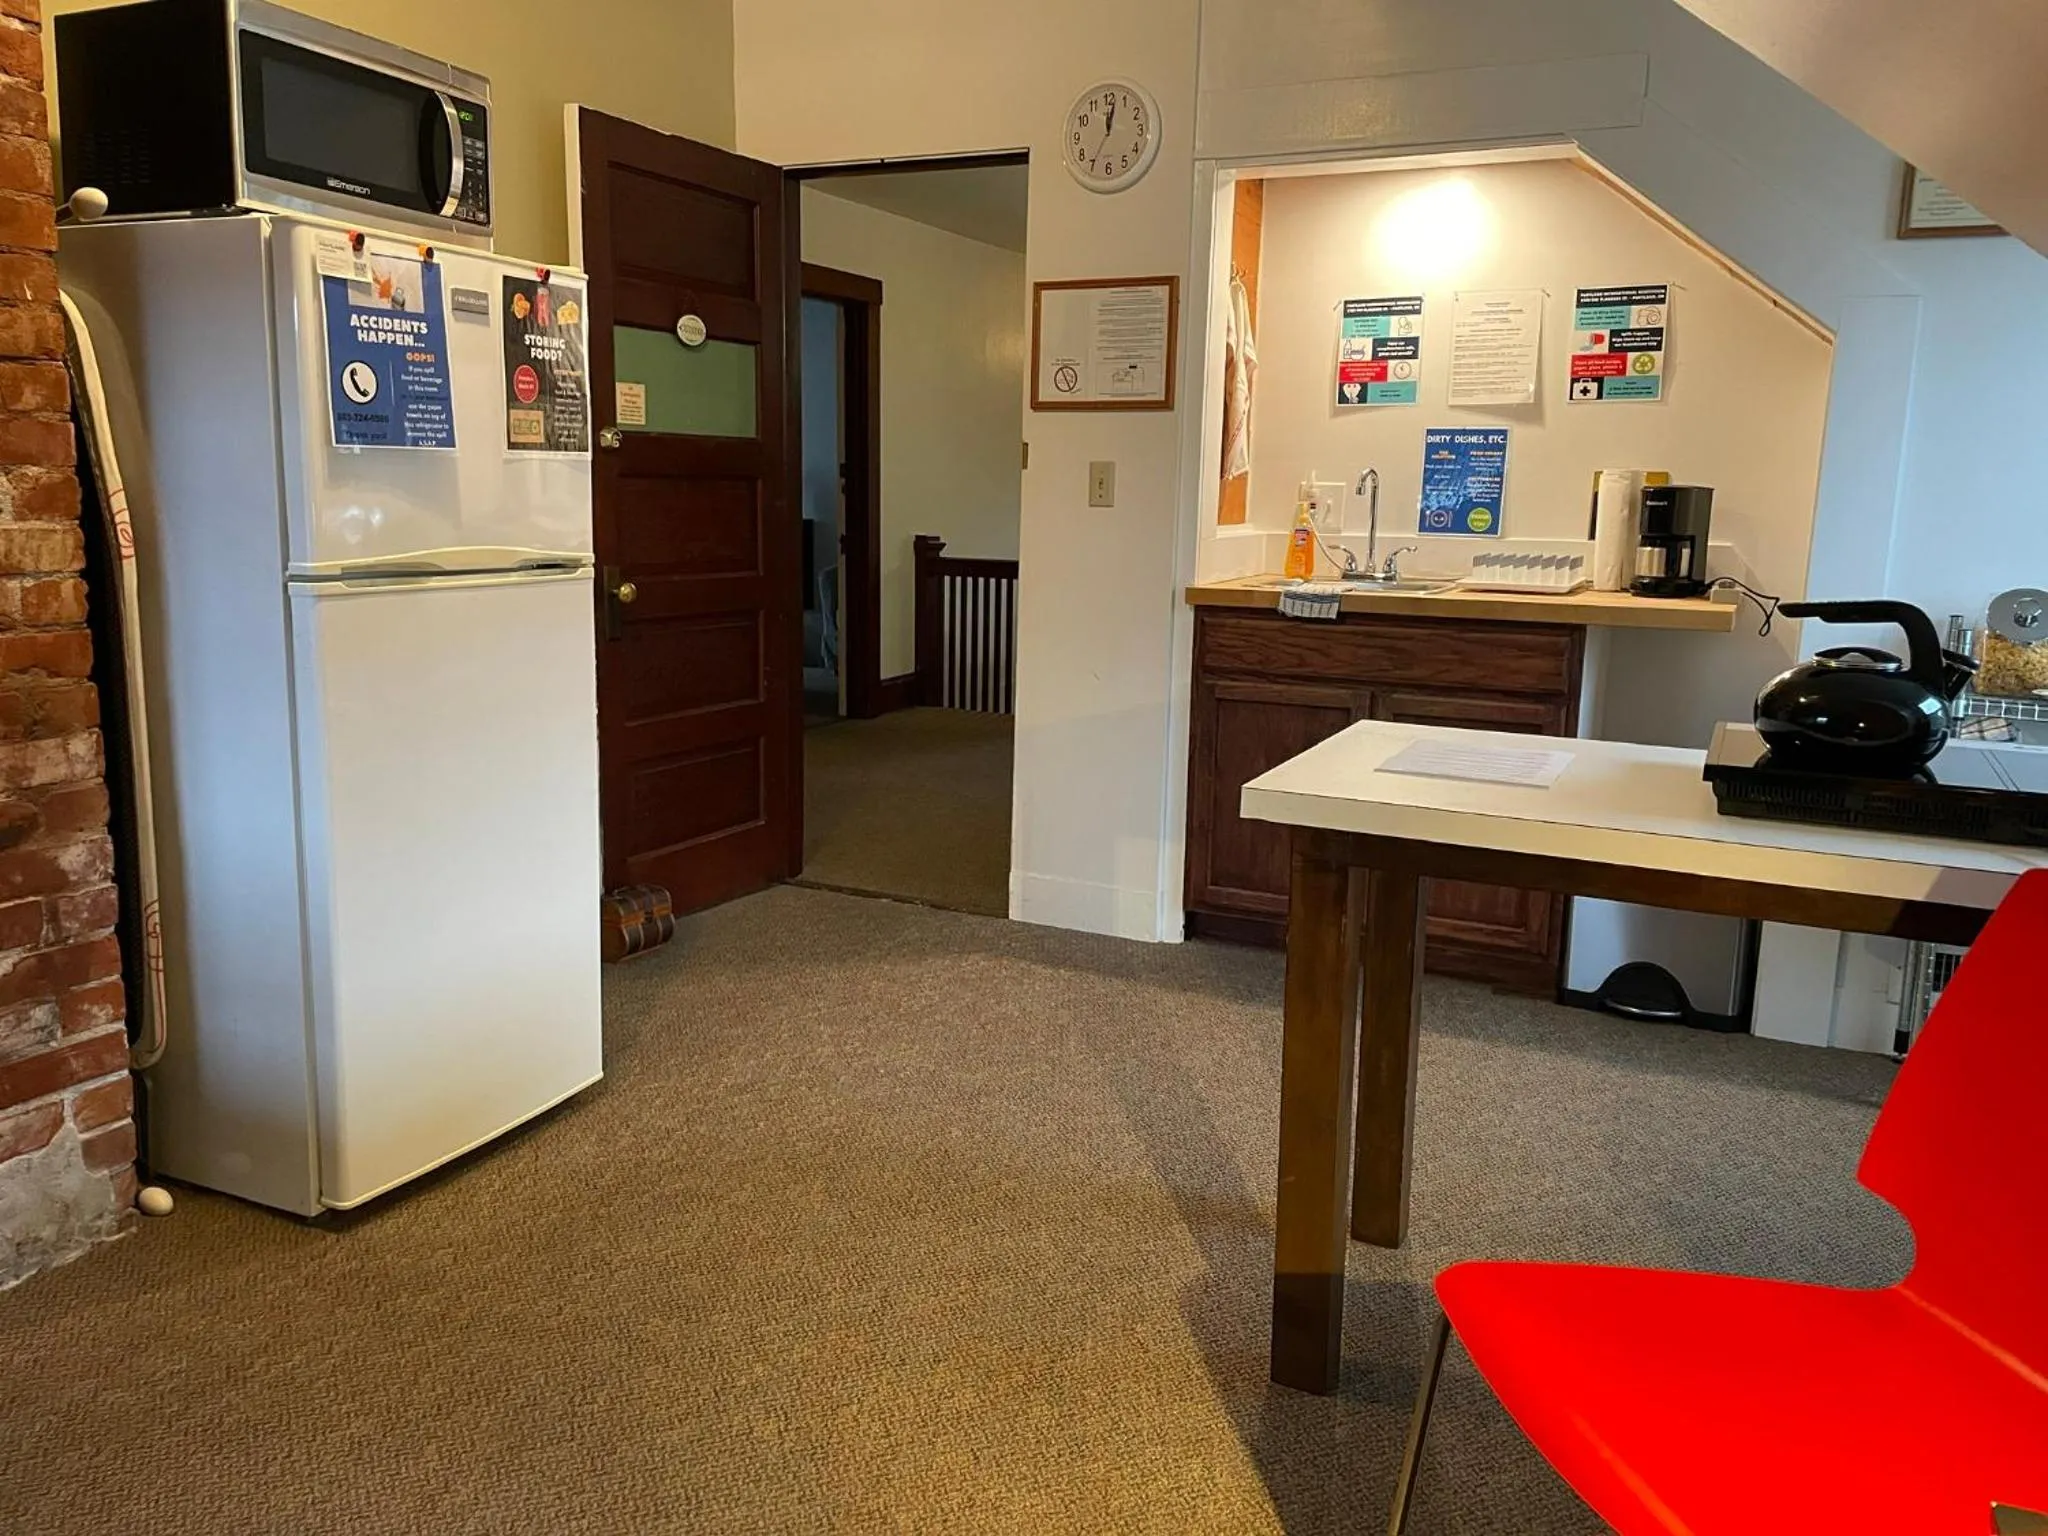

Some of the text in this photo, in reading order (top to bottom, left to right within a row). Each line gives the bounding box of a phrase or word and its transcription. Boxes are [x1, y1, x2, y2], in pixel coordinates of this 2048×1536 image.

[1089, 99, 1098, 112] 11
[1104, 92, 1115, 106] 12
[1122, 95, 1127, 108] 1
[1133, 107, 1140, 121] 2
[1078, 114, 1089, 128] 10
[1137, 123, 1144, 137] 3
[1074, 132, 1080, 145] 9
[1132, 142, 1138, 154] 4
[1079, 148, 1085, 162] 8
[1121, 155, 1128, 168] 5
[1089, 159, 1095, 172] 7
[1105, 162, 1112, 175] 6
[334, 178, 371, 195] Emerson
[350, 313, 428, 334] ACCIDENTS
[357, 329, 425, 348] HAPPEN...
[523, 334, 566, 350] STORING
[406, 351, 435, 363] OOPS!
[530, 349, 563, 362] FOOD?
[420, 376, 443, 384] beverage
[1427, 435, 1507, 444] DIRTY DISHES, ETC.
